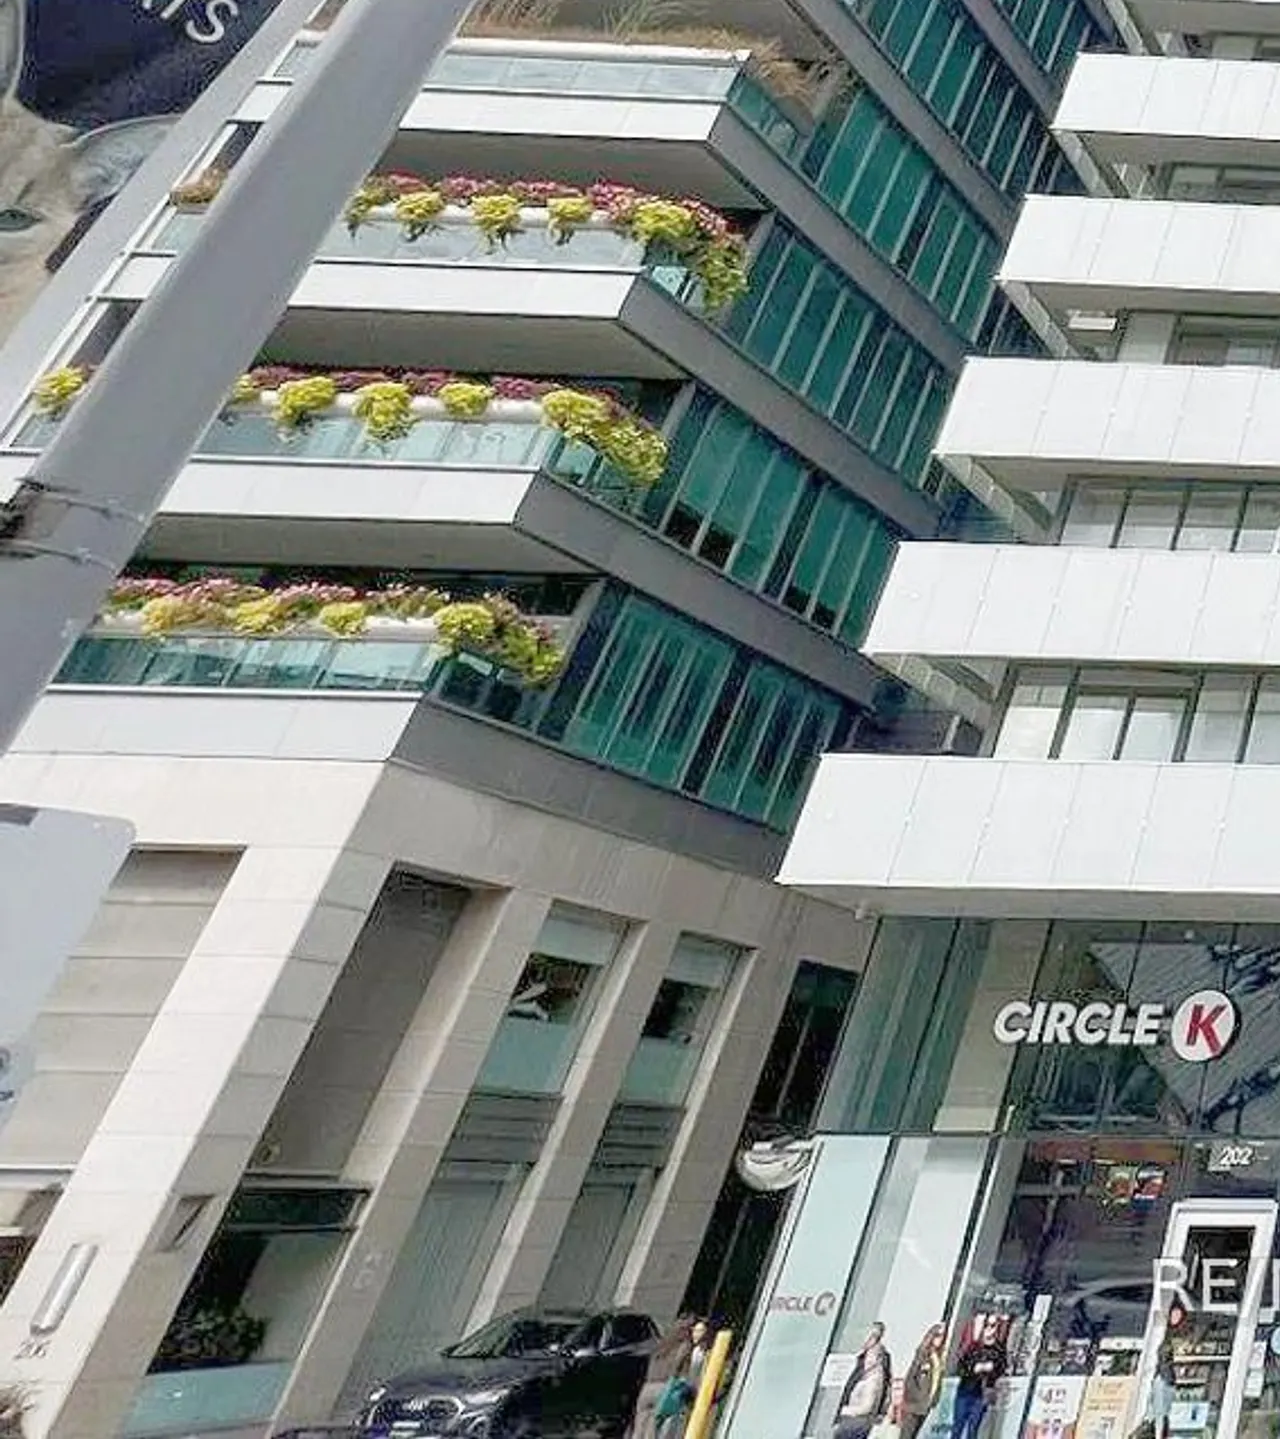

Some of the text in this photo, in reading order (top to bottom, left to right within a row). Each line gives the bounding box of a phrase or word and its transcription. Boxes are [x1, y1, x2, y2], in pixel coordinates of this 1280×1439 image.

[993, 1000, 1229, 1058] CIRCLE K
[1218, 1145, 1253, 1166] 202
